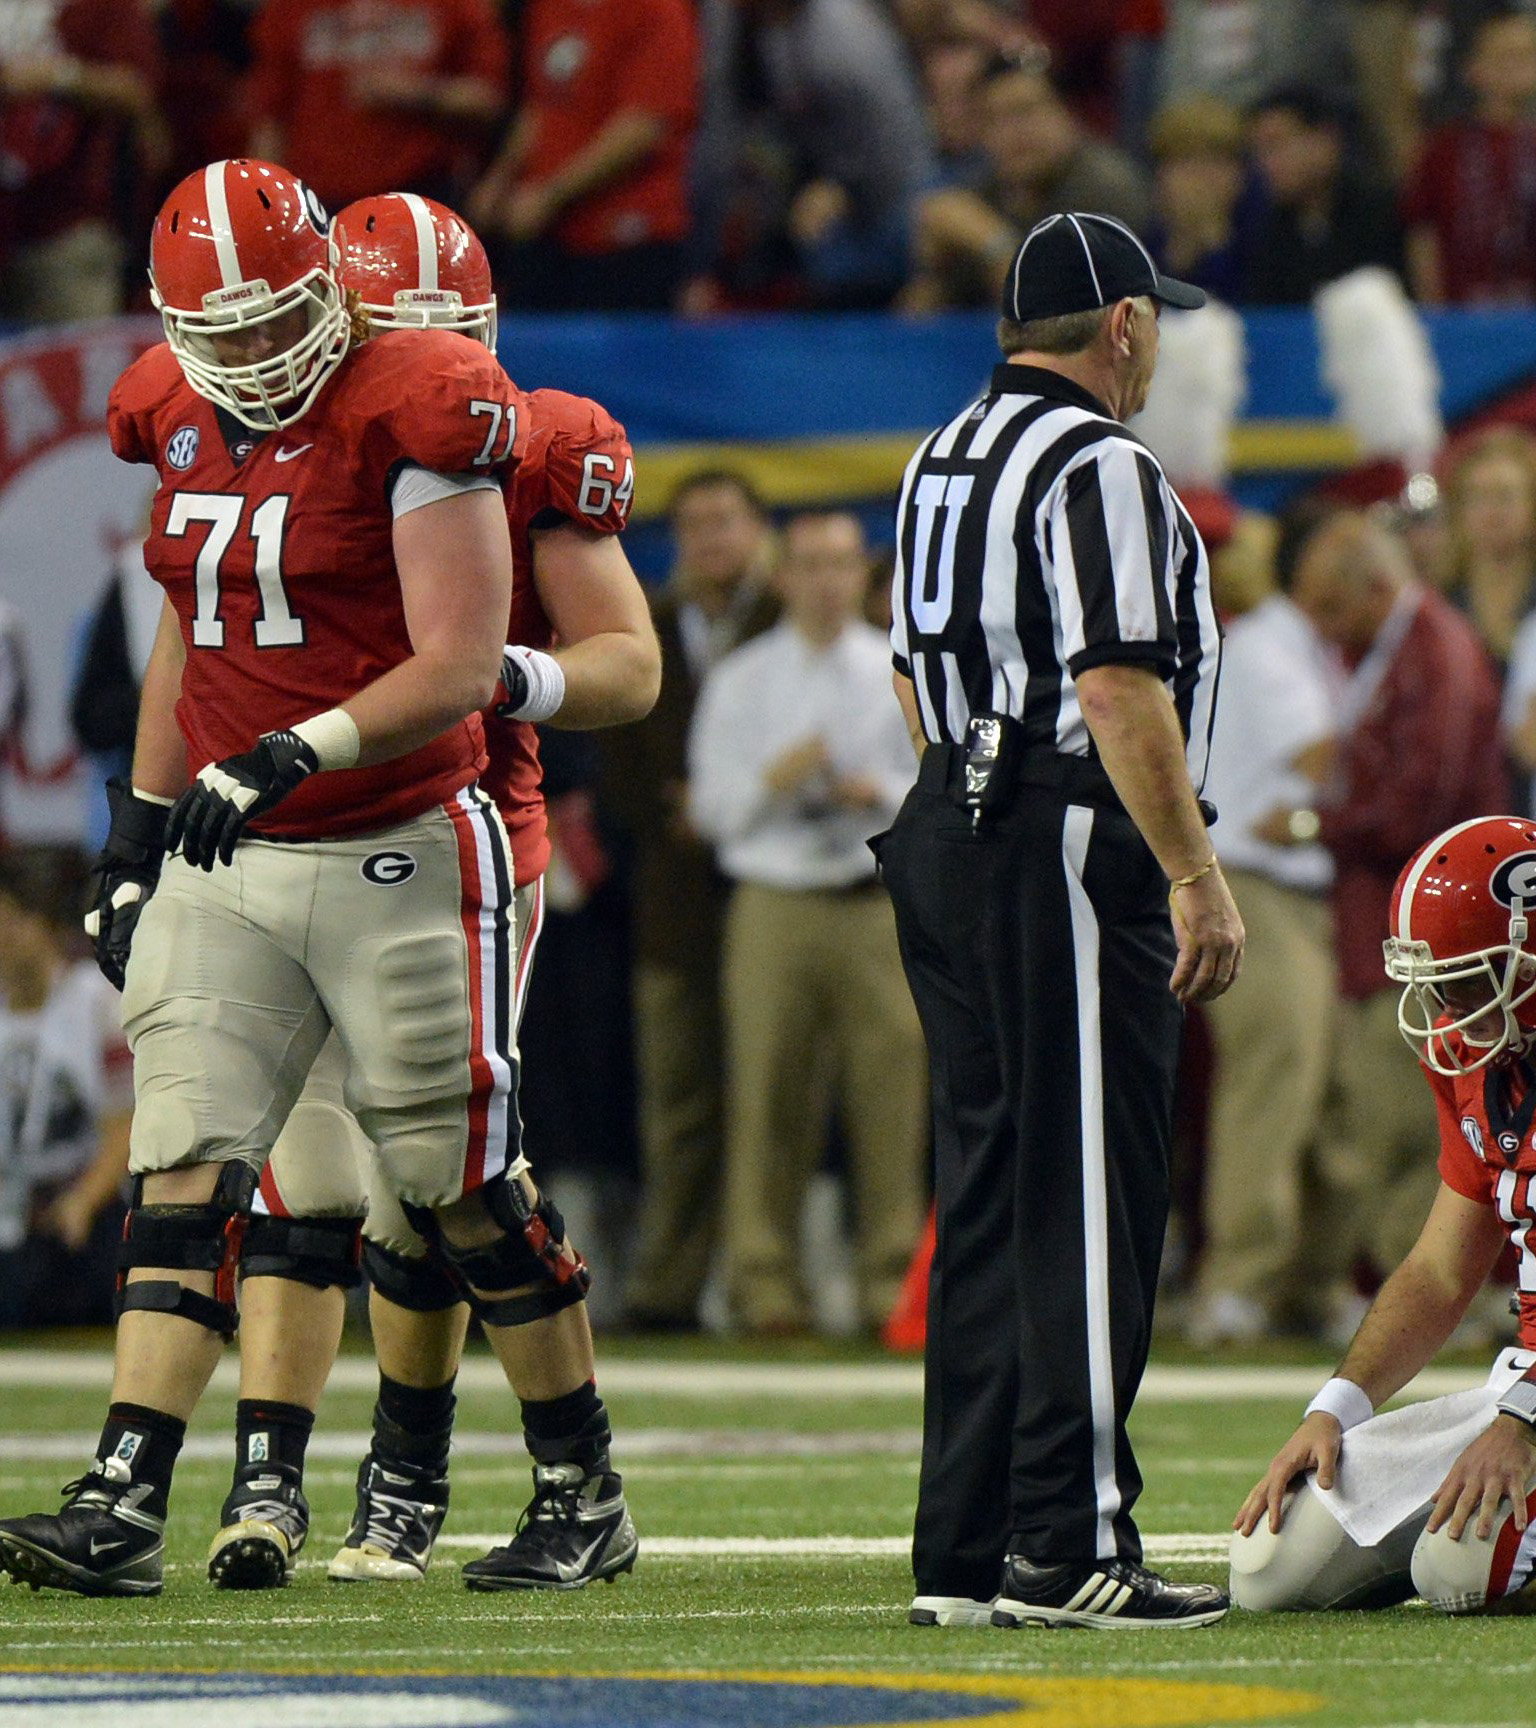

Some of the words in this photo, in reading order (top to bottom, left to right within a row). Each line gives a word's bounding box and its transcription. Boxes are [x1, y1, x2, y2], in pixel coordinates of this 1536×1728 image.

[220, 288, 253, 303] DAWGS
[412, 292, 444, 303] DAWGS
[167, 427, 198, 470] SEC
[468, 400, 517, 467] 71
[577, 452, 636, 520] 64
[163, 490, 305, 648] 71
[910, 474, 976, 635] U
[361, 850, 417, 886] G
[1498, 1132, 1520, 1153] G
